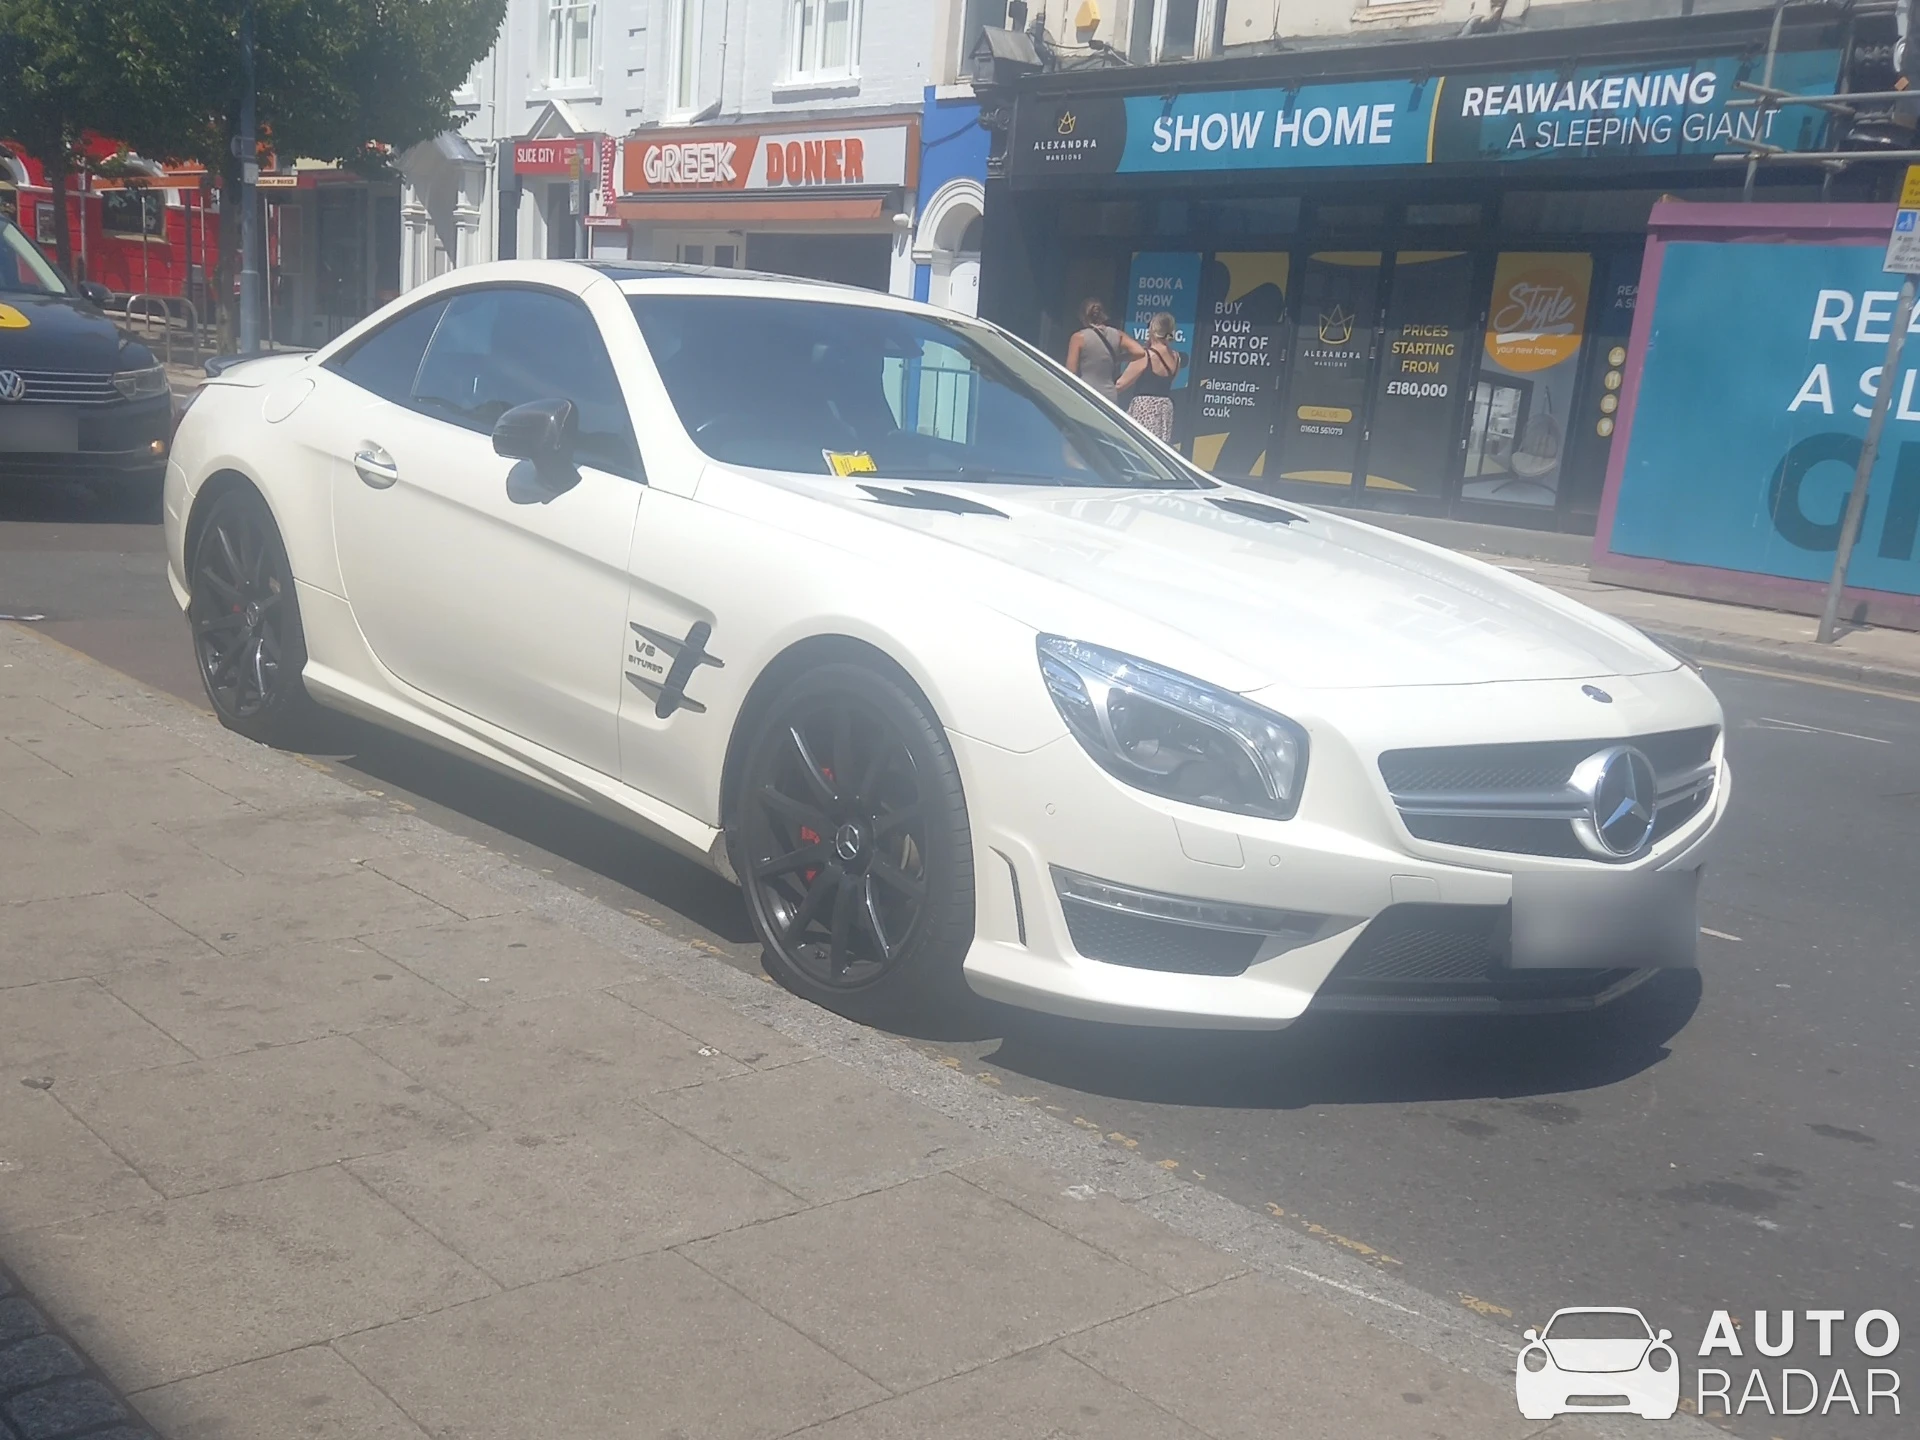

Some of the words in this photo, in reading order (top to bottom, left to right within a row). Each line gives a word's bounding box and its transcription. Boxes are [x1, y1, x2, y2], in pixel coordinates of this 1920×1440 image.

[1462, 72, 1716, 117] REAWAKENING
[1151, 111, 1264, 153] SHOW
[1274, 104, 1395, 148] HOME
[1506, 122, 1526, 149] A
[1535, 115, 1671, 147] SLEEPING
[1683, 110, 1781, 142] GIANT
[1033, 139, 1097, 151] ALEXANDRA
[517, 147, 537, 163] SLICE
[538, 147, 555, 163] CITY
[643, 140, 737, 185] GREEK
[766, 138, 864, 184] DONER
[1046, 153, 1082, 161] MANSIONS
[1139, 277, 1173, 289] BOOK
[1174, 278, 1183, 290] A
[1137, 294, 1173, 307] SHOW
[1494, 282, 1576, 333] Style
[1215, 301, 1242, 315] BUY
[1214, 320, 1251, 333] YOUR
[1402, 324, 1449, 337] PRICES
[1211, 335, 1245, 349] PART
[1249, 337, 1268, 350] OF
[1391, 341, 1454, 356] STARTING
[1303, 350, 1361, 360] ALEXANDRA
[1496, 346, 1514, 355] your
[1534, 346, 1557, 355] home
[1209, 351, 1270, 366] HISTORY.
[1401, 360, 1439, 373] FROM
[1206, 378, 1260, 393] alexandra-
[1387, 381, 1448, 398] £180,000
[1787, 363, 1834, 414] A
[1204, 393, 1256, 407] mansions.
[1203, 406, 1231, 418] co.uk
[1311, 409, 1326, 418] CALL
[1300, 425, 1319, 434] 01603
[636, 640, 655, 656] V8
[629, 655, 662, 673] BITURBO
